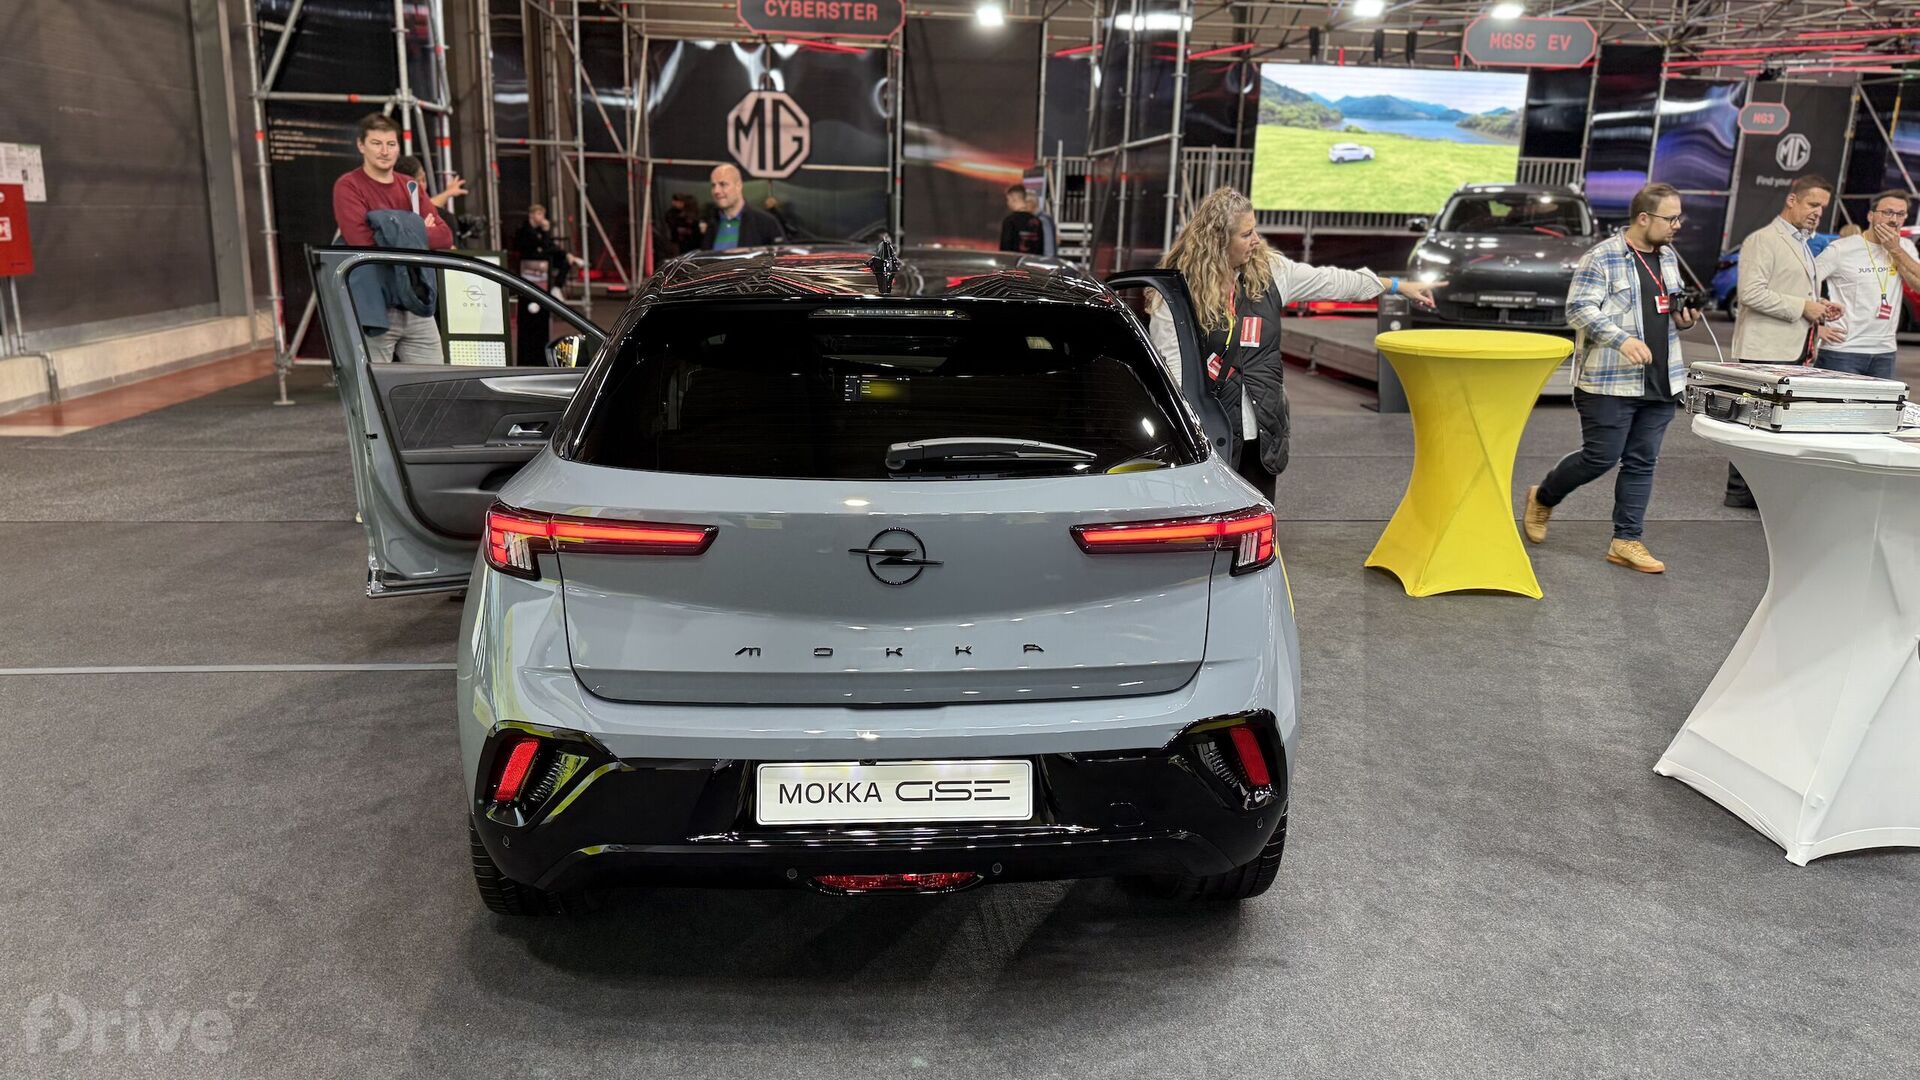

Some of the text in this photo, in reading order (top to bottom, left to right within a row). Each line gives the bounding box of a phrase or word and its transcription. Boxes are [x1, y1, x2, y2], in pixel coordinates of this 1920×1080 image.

[764, 1, 878, 21] CYBERSTER
[1489, 32, 1572, 51] MGS5 EV
[735, 97, 804, 172] MG
[1779, 137, 1808, 167] MG
[735, 643, 1044, 657] MOKKA
[779, 780, 1010, 804] MOKKA GSE
